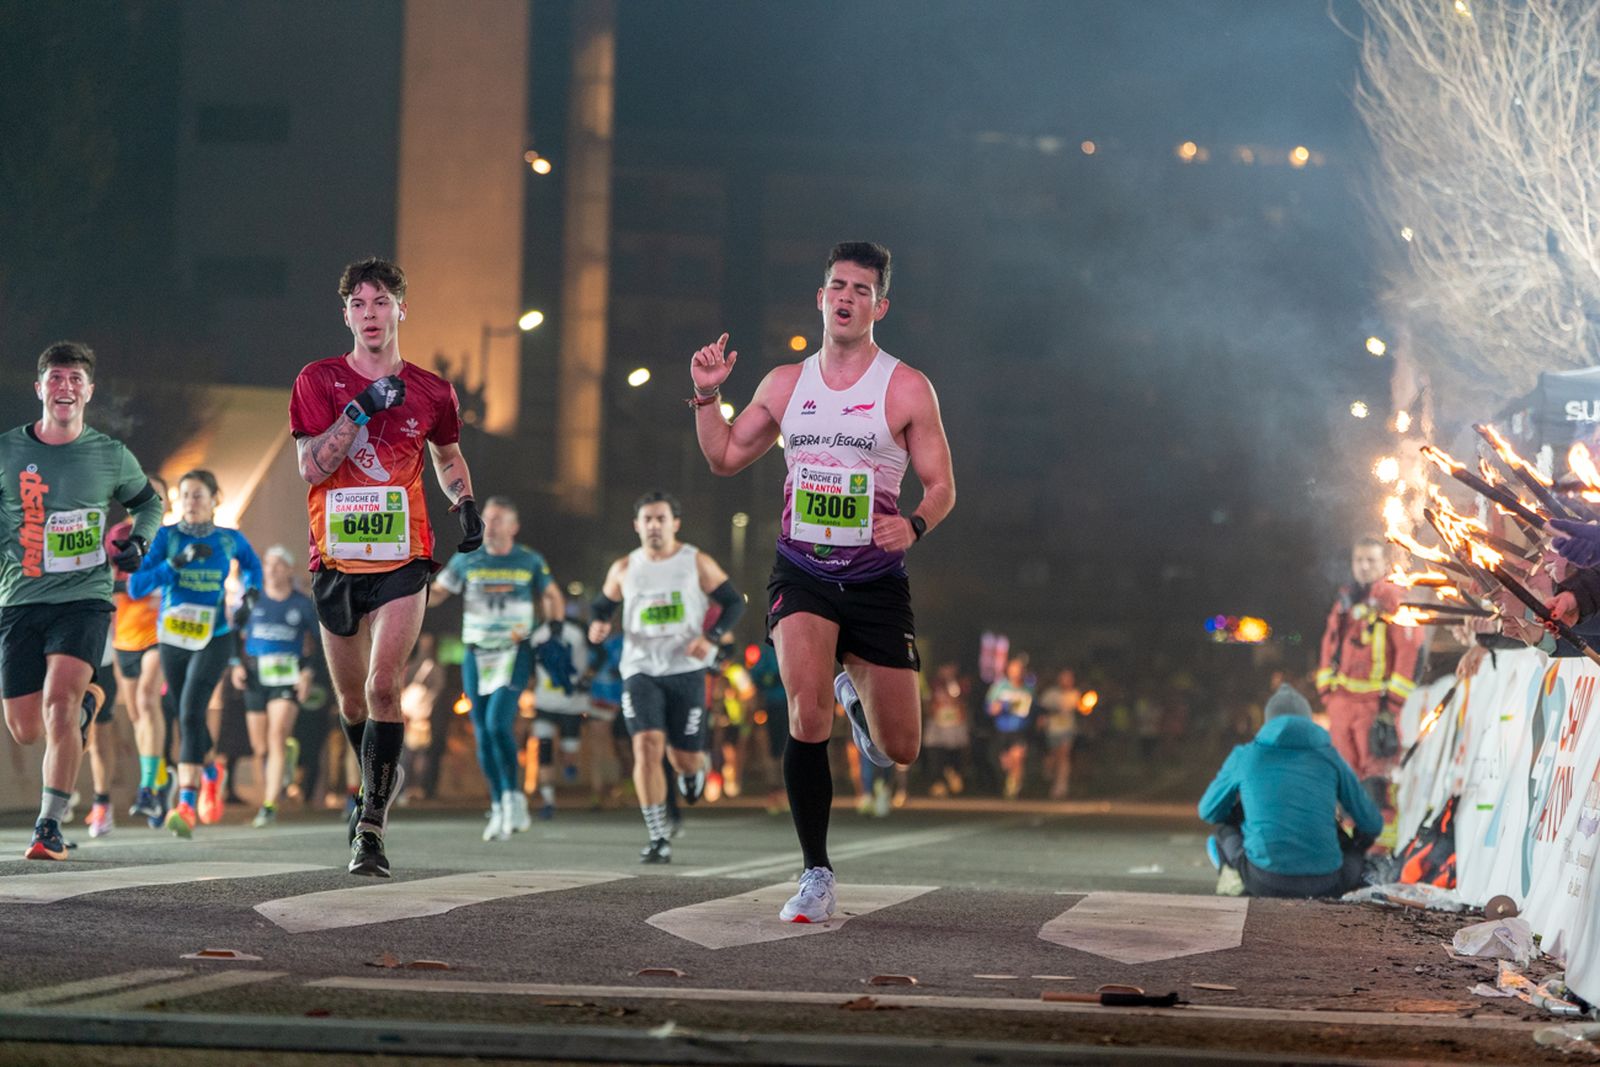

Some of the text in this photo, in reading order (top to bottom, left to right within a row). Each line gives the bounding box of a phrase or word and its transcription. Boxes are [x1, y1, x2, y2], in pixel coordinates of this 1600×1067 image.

[821, 436, 831, 444] DE
[830, 433, 873, 451] SEGURA
[354, 448, 375, 468] 43
[801, 481, 814, 490] SAN
[809, 474, 842, 484] NOCHE DE
[345, 494, 379, 503] NOCHE DE
[806, 492, 857, 519] 7306
[336, 504, 352, 512] SAN
[343, 513, 394, 535] 6497
[57, 529, 93, 552] 7035
